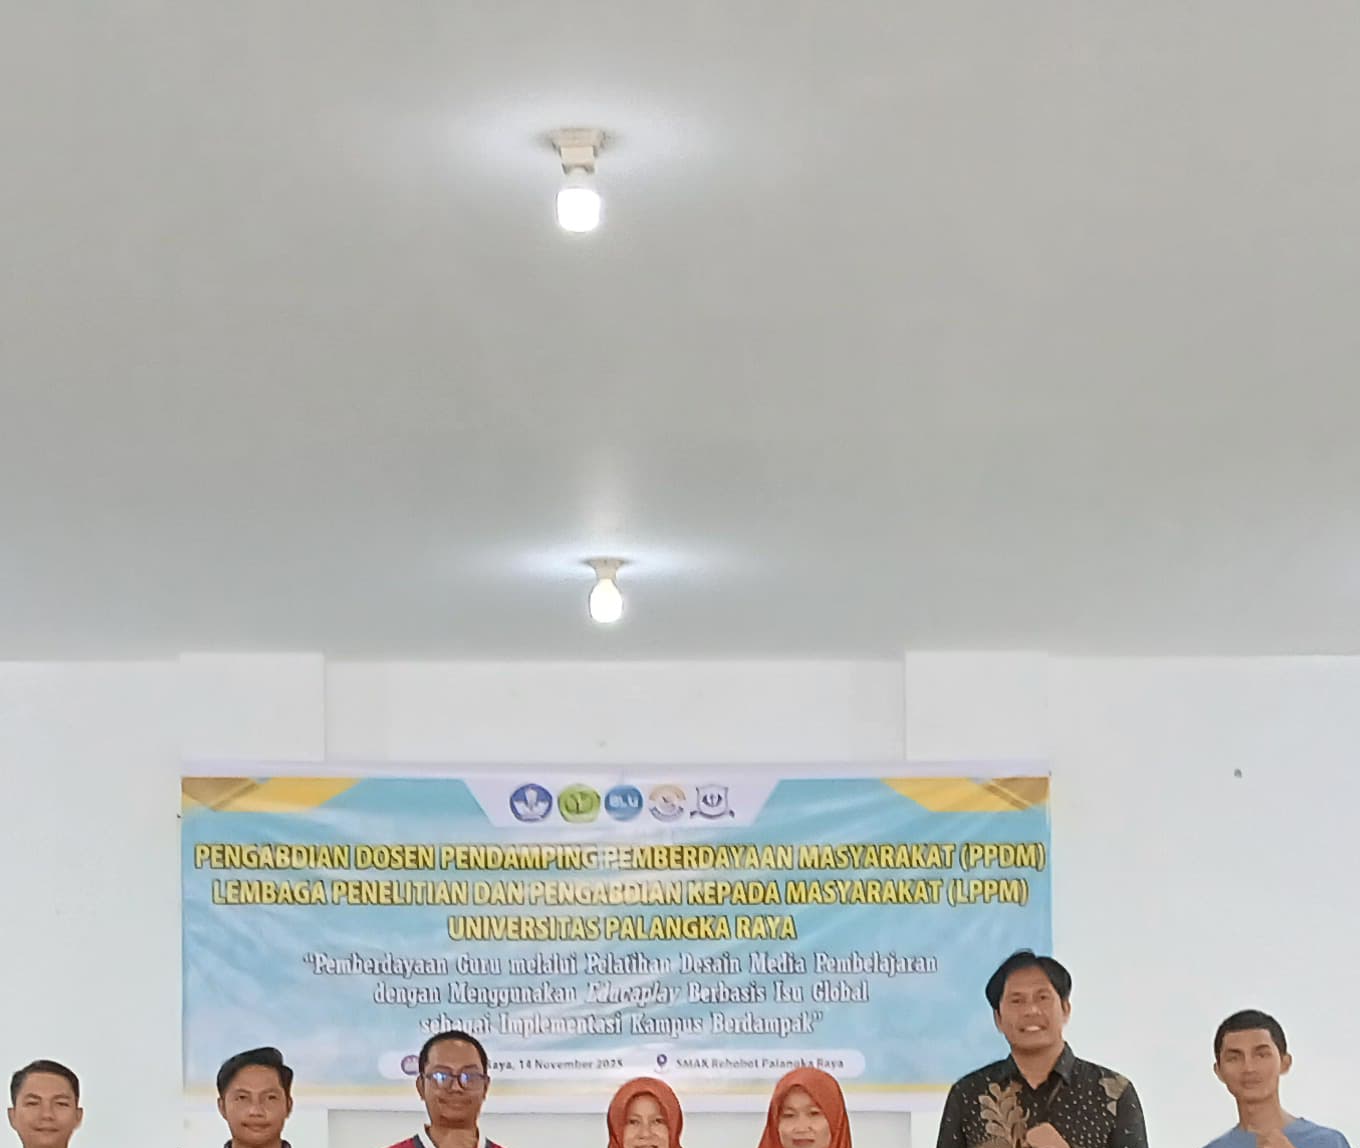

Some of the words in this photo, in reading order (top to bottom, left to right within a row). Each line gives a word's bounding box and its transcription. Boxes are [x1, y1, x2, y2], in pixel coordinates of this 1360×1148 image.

[194, 843, 350, 870] PENGABDIAN
[354, 844, 436, 870] DOSEN
[440, 844, 599, 870] PENDAMPING
[603, 844, 793, 870] PEMBERDAYAAN
[798, 843, 956, 870] MASYARAKAT
[959, 841, 1047, 872] (PPDM)
[212, 879, 328, 905] LEMBAGA
[331, 879, 469, 905] PENELITIAN
[473, 880, 525, 905] DAN
[529, 880, 682, 905] PENGABDIAN
[687, 879, 781, 905] KEPADA
[786, 879, 943, 904] MASYARAKAT
[947, 878, 1029, 907] (LPPM)
[447, 915, 601, 941] UNIVERSITAS
[605, 914, 731, 941] PALANGKA
[736, 914, 798, 940] RAYA
[455, 953, 502, 976] Guru
[509, 951, 578, 976] melalui
[584, 951, 672, 975] Pelatihan
[679, 952, 742, 975] Desain
[749, 952, 807, 975] Media
[814, 951, 938, 977] Pembelajaran
[373, 982, 440, 1007] dengan
[447, 981, 577, 1008] Menggunakan
[688, 981, 767, 1003] Berbasis
[774, 981, 804, 1002] Isu
[811, 980, 870, 1002] Global
[419, 1011, 491, 1037] sebagai
[499, 1011, 622, 1038] Implementasi
[630, 1012, 704, 1038] Kampus
[534, 1059, 593, 1070] November
